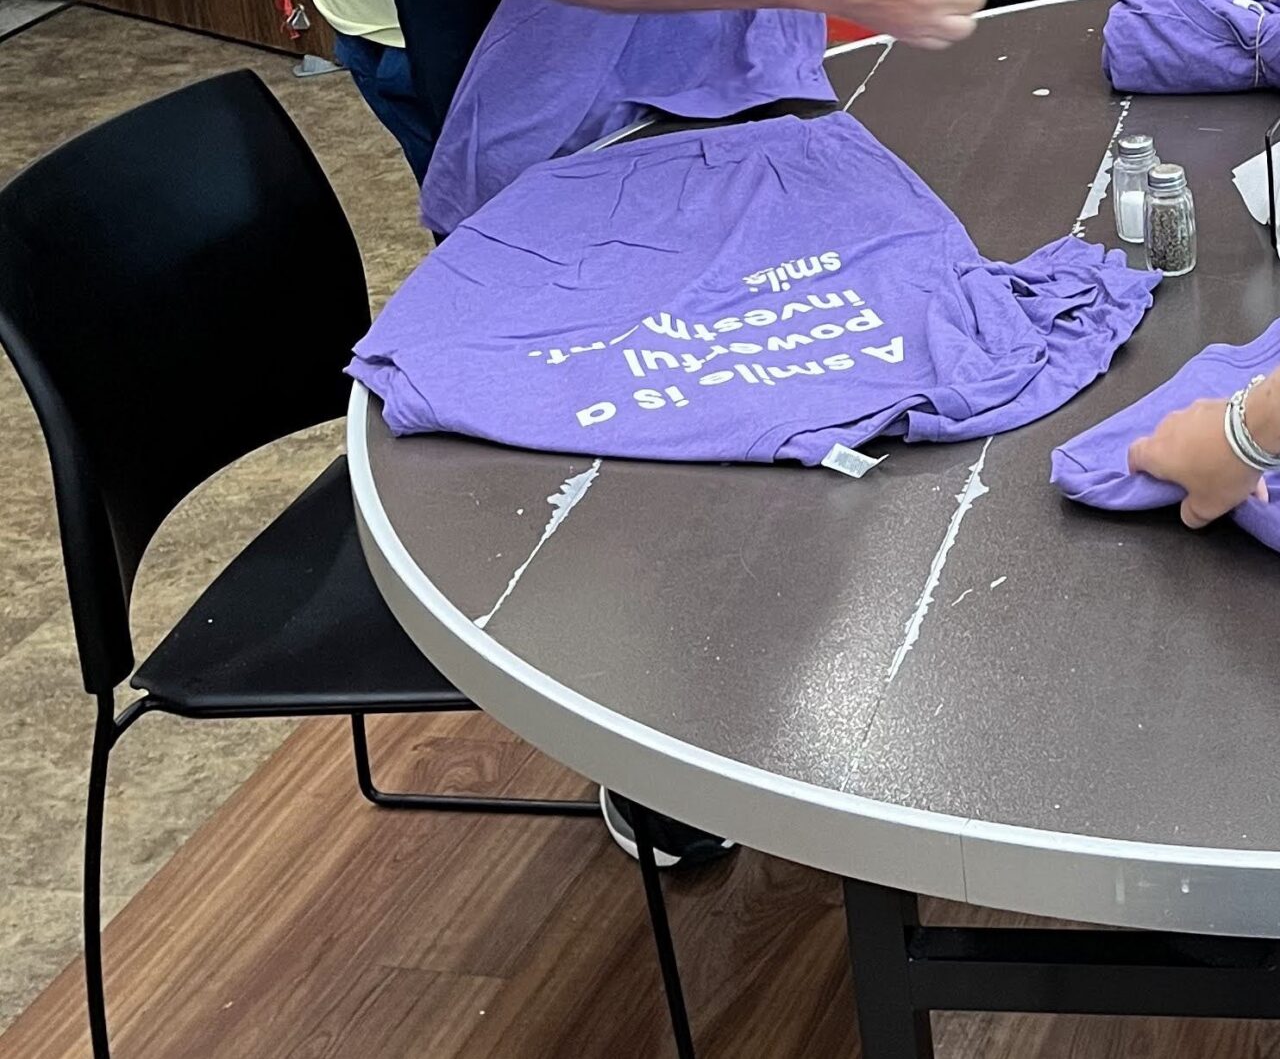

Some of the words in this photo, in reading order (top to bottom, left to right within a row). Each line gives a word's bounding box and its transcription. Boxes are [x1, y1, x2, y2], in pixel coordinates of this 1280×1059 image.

[622, 308, 886, 378] powerful
[859, 336, 904, 364] A
[698, 353, 856, 386] smile
[632, 385, 690, 410] is
[575, 401, 617, 428] a
